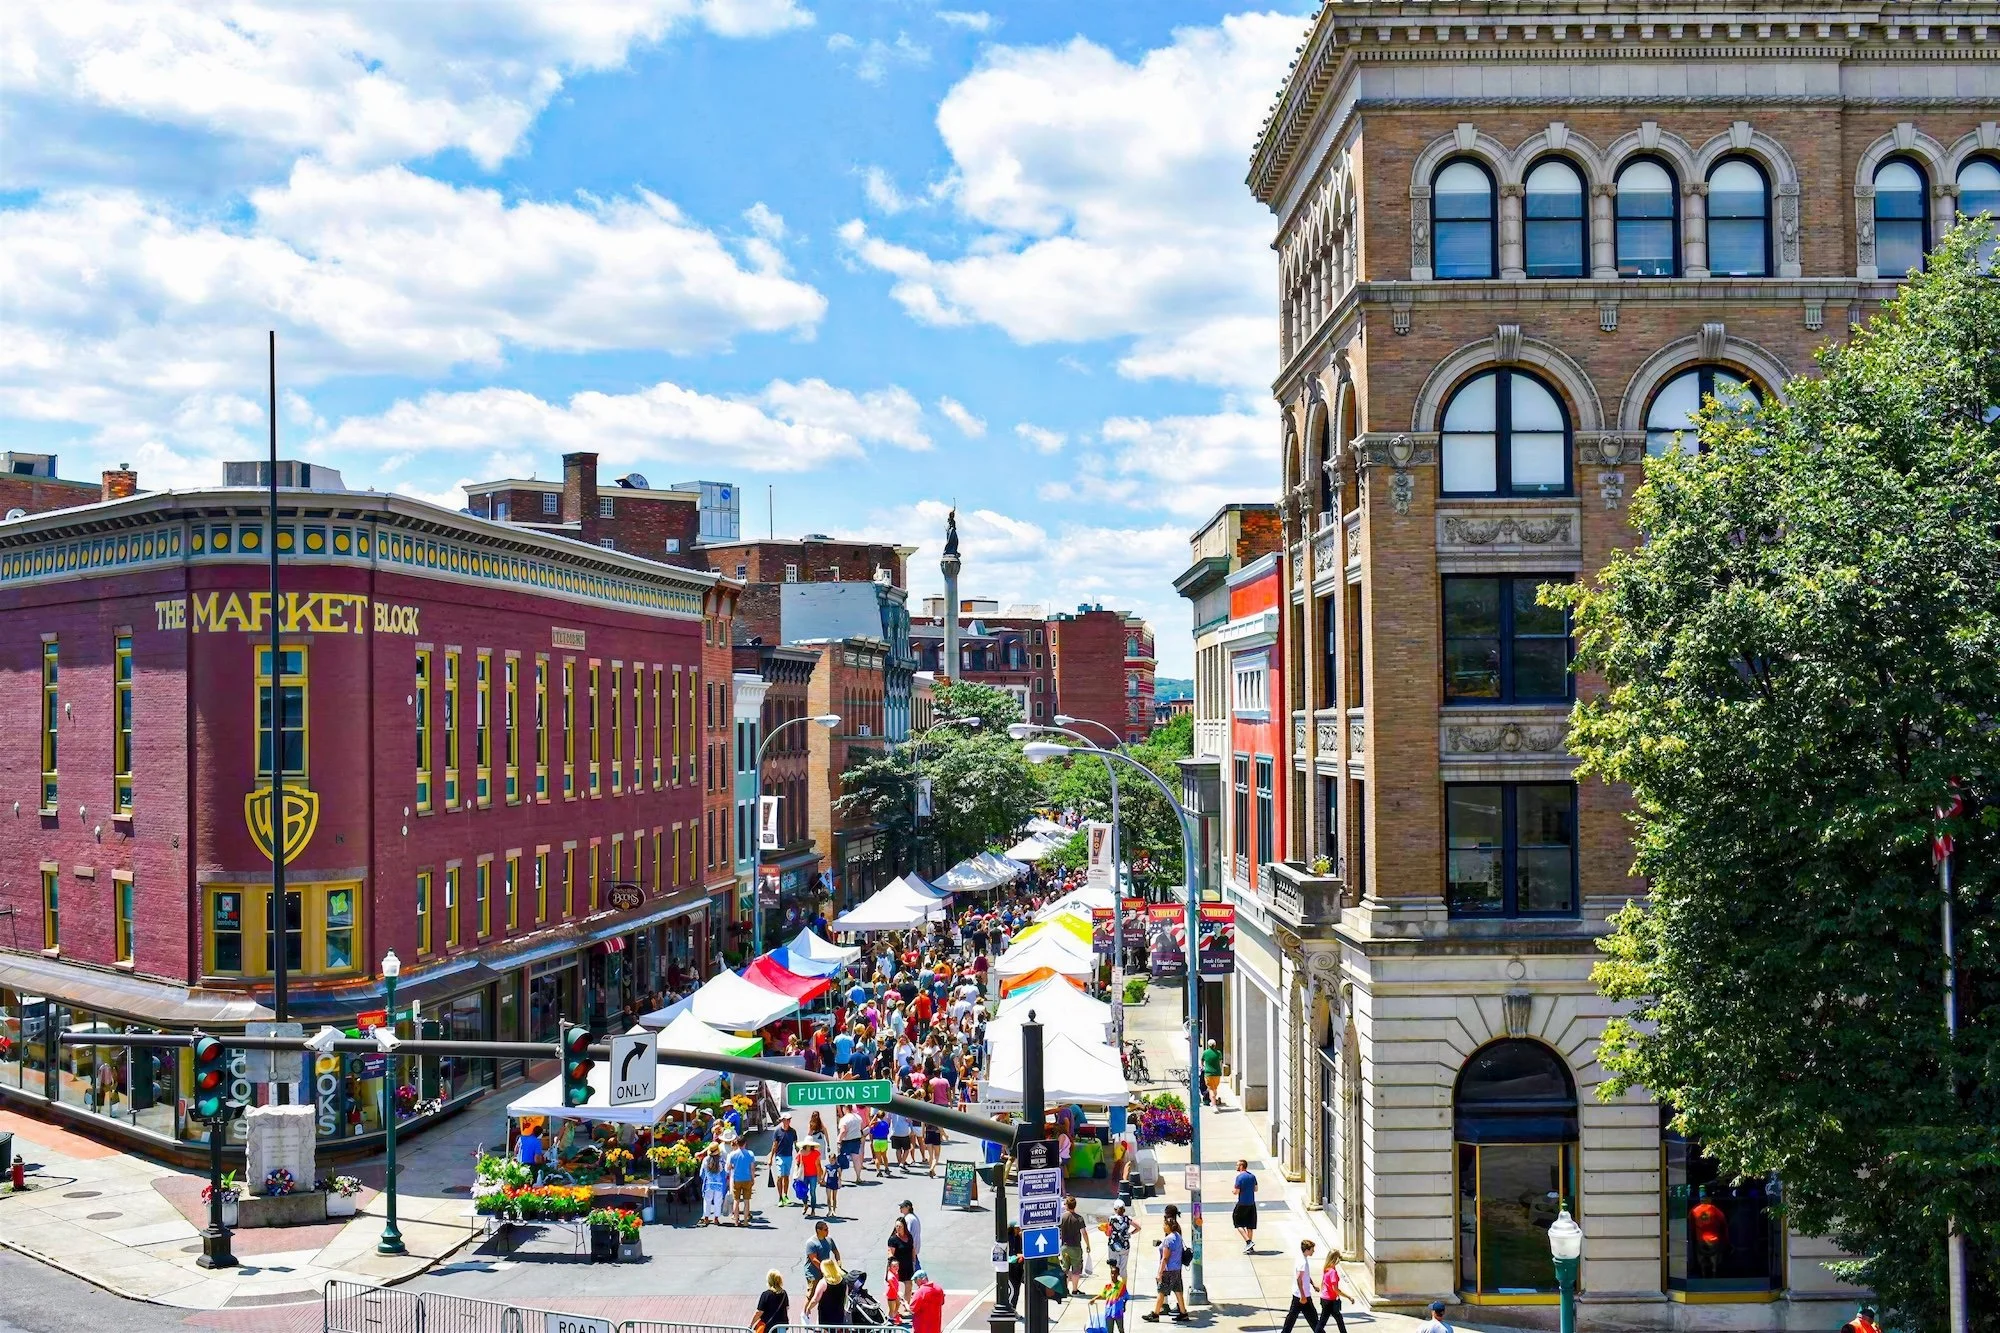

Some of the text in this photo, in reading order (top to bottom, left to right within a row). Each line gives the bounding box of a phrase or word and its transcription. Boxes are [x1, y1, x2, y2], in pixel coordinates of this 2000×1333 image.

[155, 592, 420, 636] THE MARKET BLOCK
[613, 893, 639, 905] BOOKS
[316, 1053, 338, 1135] OOKS
[617, 1083, 650, 1099] ONLY
[798, 1085, 880, 1101] FULTON ST
[1025, 1201, 1057, 1211] HART CLUETT
[1030, 1209, 1053, 1218] MANSION
